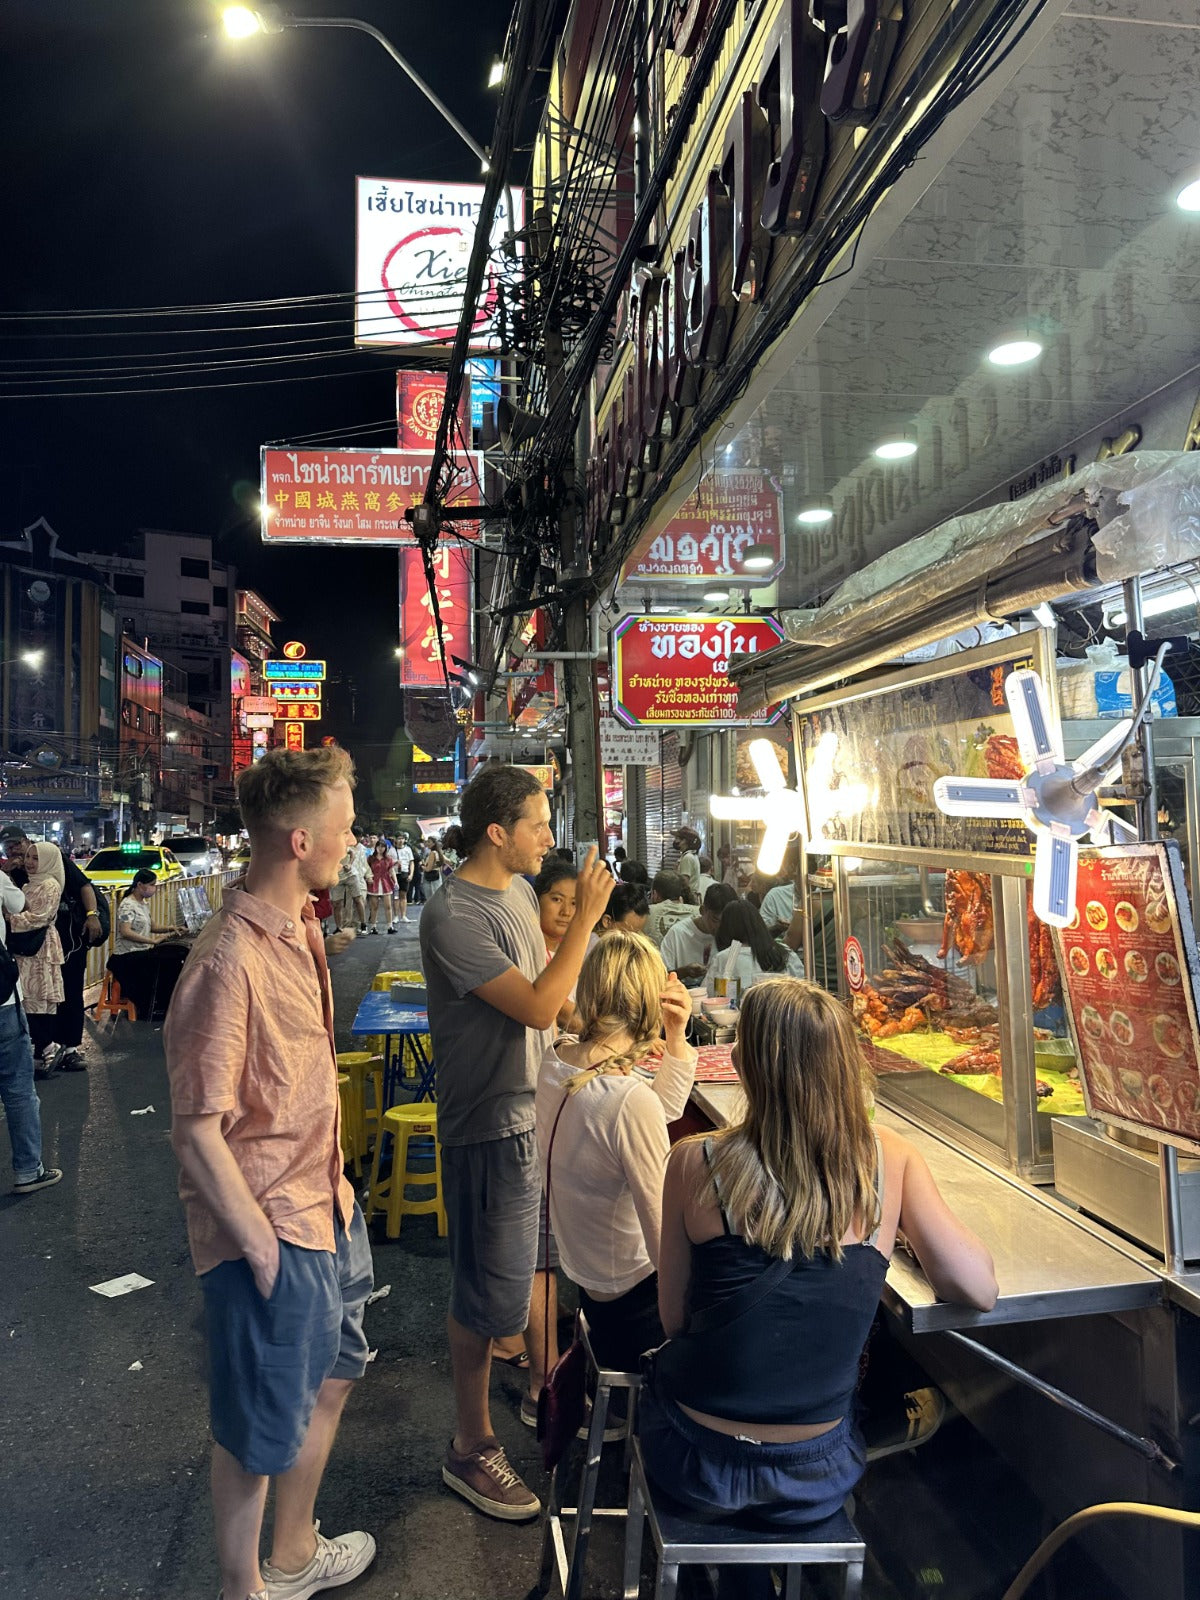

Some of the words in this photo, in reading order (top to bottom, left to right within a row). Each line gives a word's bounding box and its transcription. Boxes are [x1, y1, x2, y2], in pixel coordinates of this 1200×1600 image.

[414, 249, 466, 279] Xie
[400, 282, 465, 298] Chinato
[406, 416, 425, 437] TONG
[274, 490, 472, 513] 中國城燕窩參茸行
[629, 674, 672, 688] จำหน่าย
